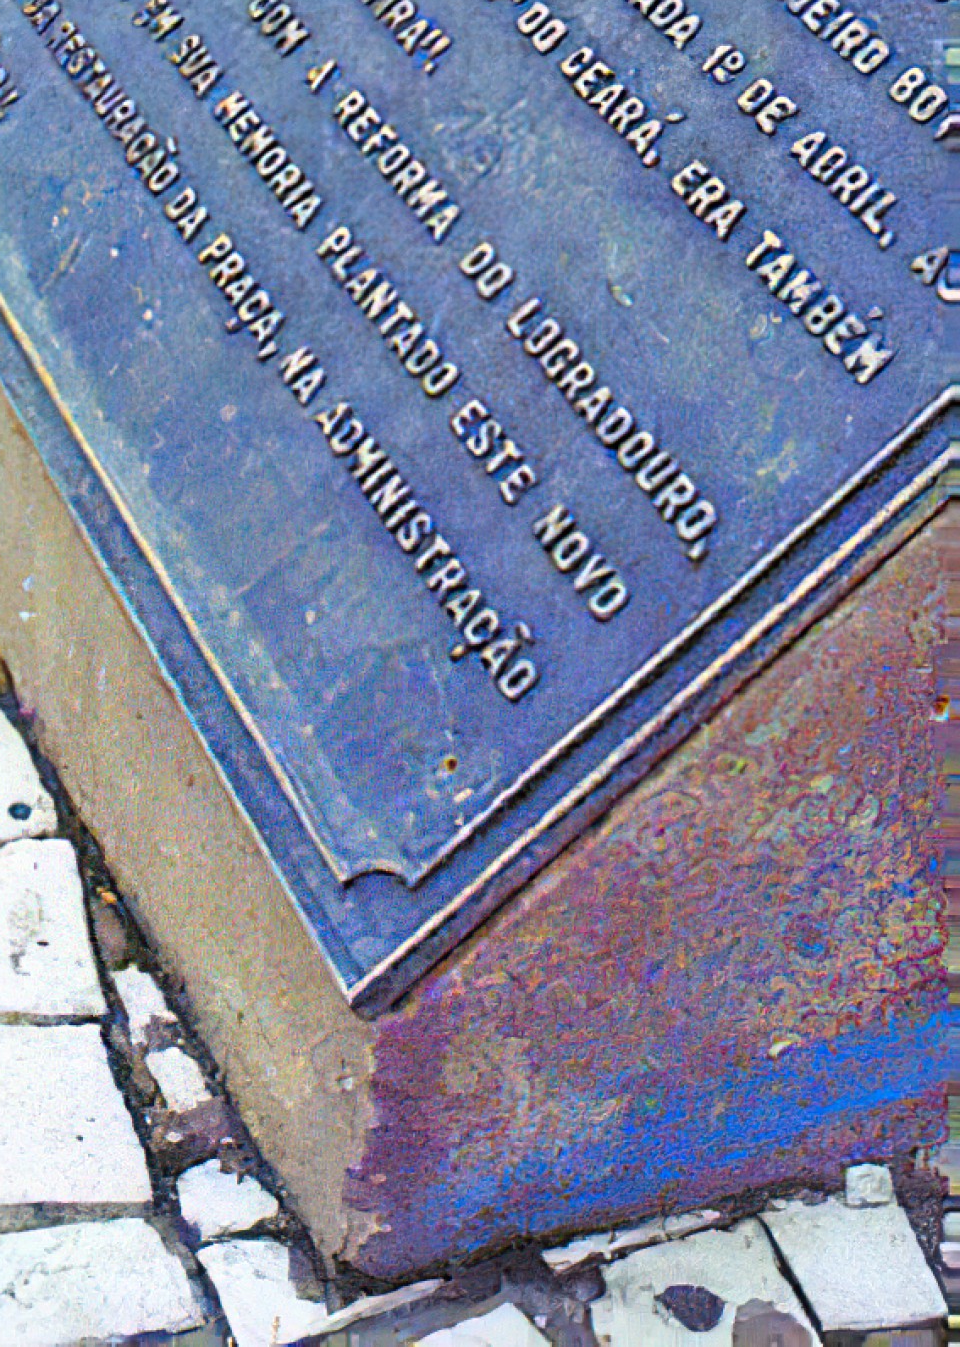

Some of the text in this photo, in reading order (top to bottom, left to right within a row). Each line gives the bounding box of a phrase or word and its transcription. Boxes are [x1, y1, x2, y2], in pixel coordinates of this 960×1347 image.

[169, 34, 226, 98] SUA
[211, 90, 330, 229] MEMORIA
[316, 227, 462, 399] PLANTADO
[448, 400, 539, 504] ESTE
[530, 505, 632, 622] NOVO
[303, 58, 337, 92] A
[330, 93, 465, 241] REFORMA
[459, 244, 513, 299] DO
[504, 299, 723, 560] LOGRADOURO,
[514, 2, 569, 54] DO
[668, 160, 752, 240] ERA
[738, 232, 895, 383] TAMBÉM
[735, 80, 796, 134] DE
[164, 187, 212, 242] DA
[277, 345, 328, 404] NA
[311, 397, 545, 701] ADMINISTRAÇÃO
